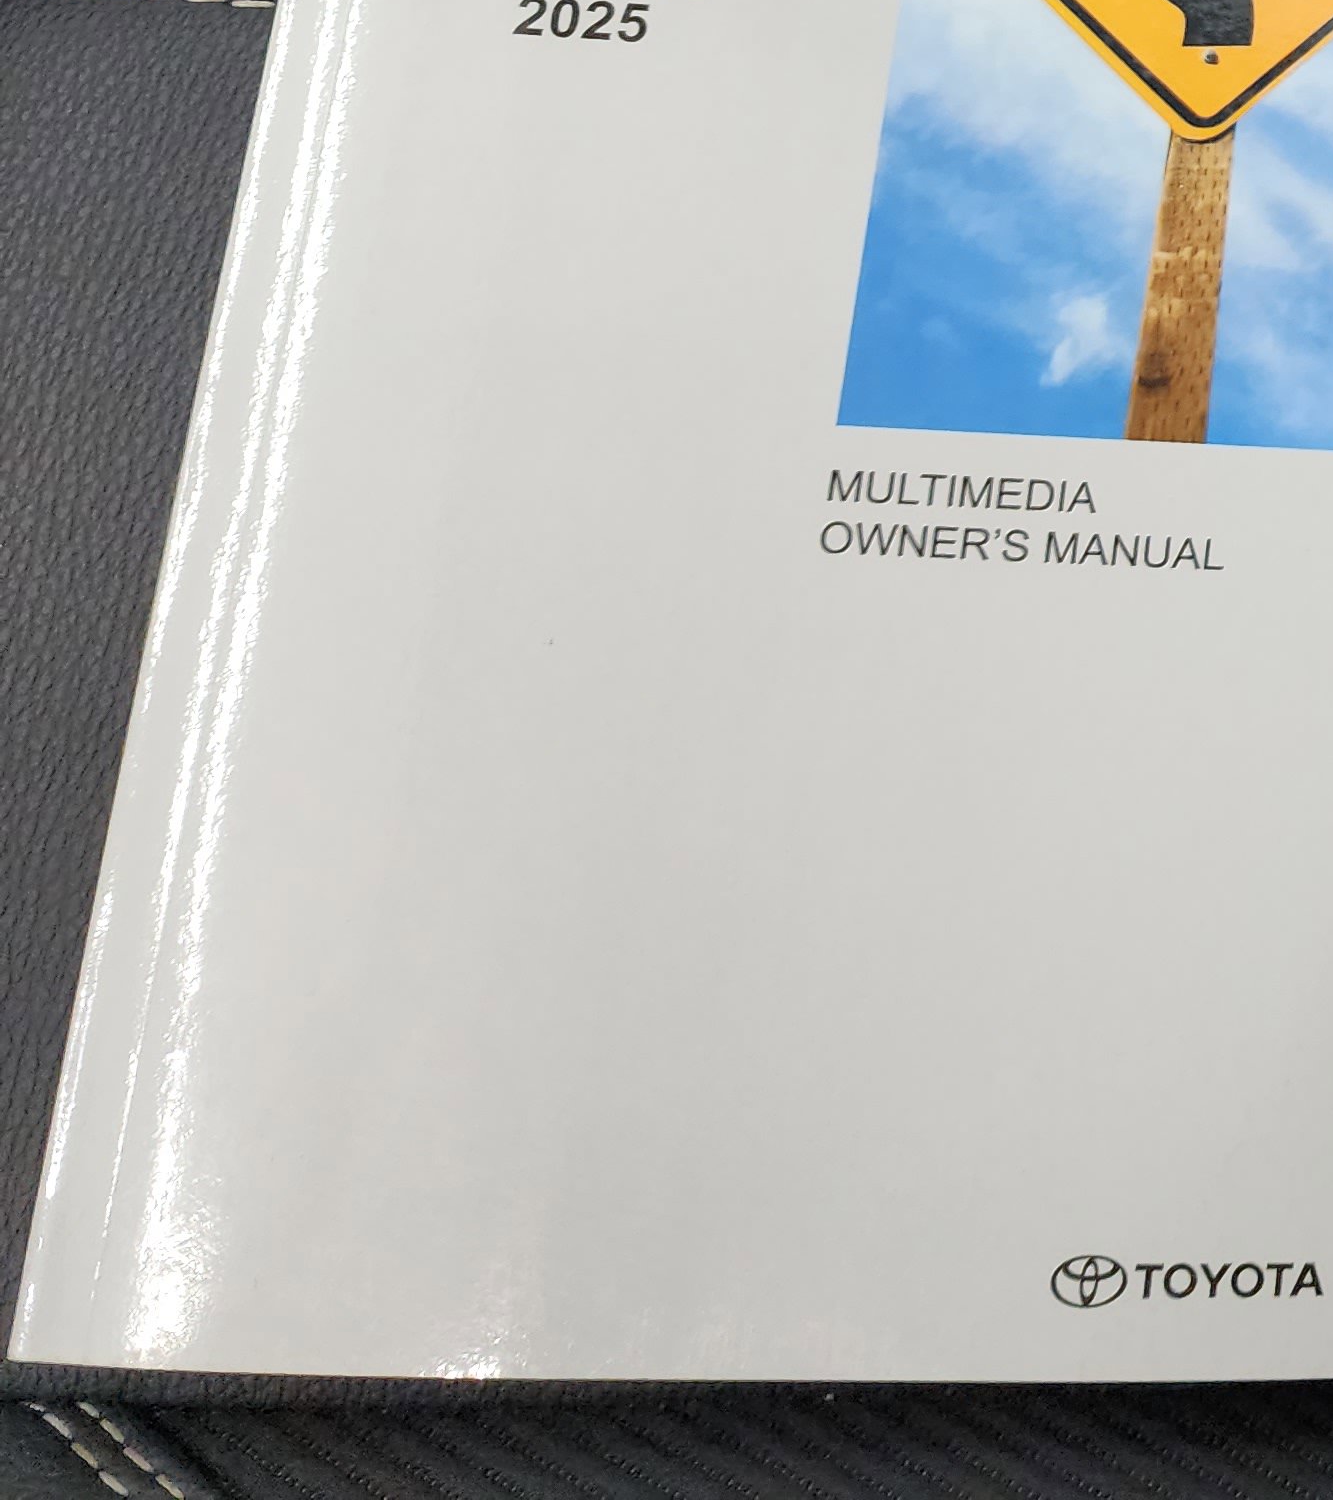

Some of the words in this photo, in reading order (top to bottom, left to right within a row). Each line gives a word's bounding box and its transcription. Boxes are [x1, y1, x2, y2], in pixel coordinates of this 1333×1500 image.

[826, 468, 1097, 514] MULTIMEDIA
[819, 520, 1030, 562] OWNER'S
[1043, 531, 1225, 571] MANUAL
[1134, 1261, 1324, 1300] TOYOTA
